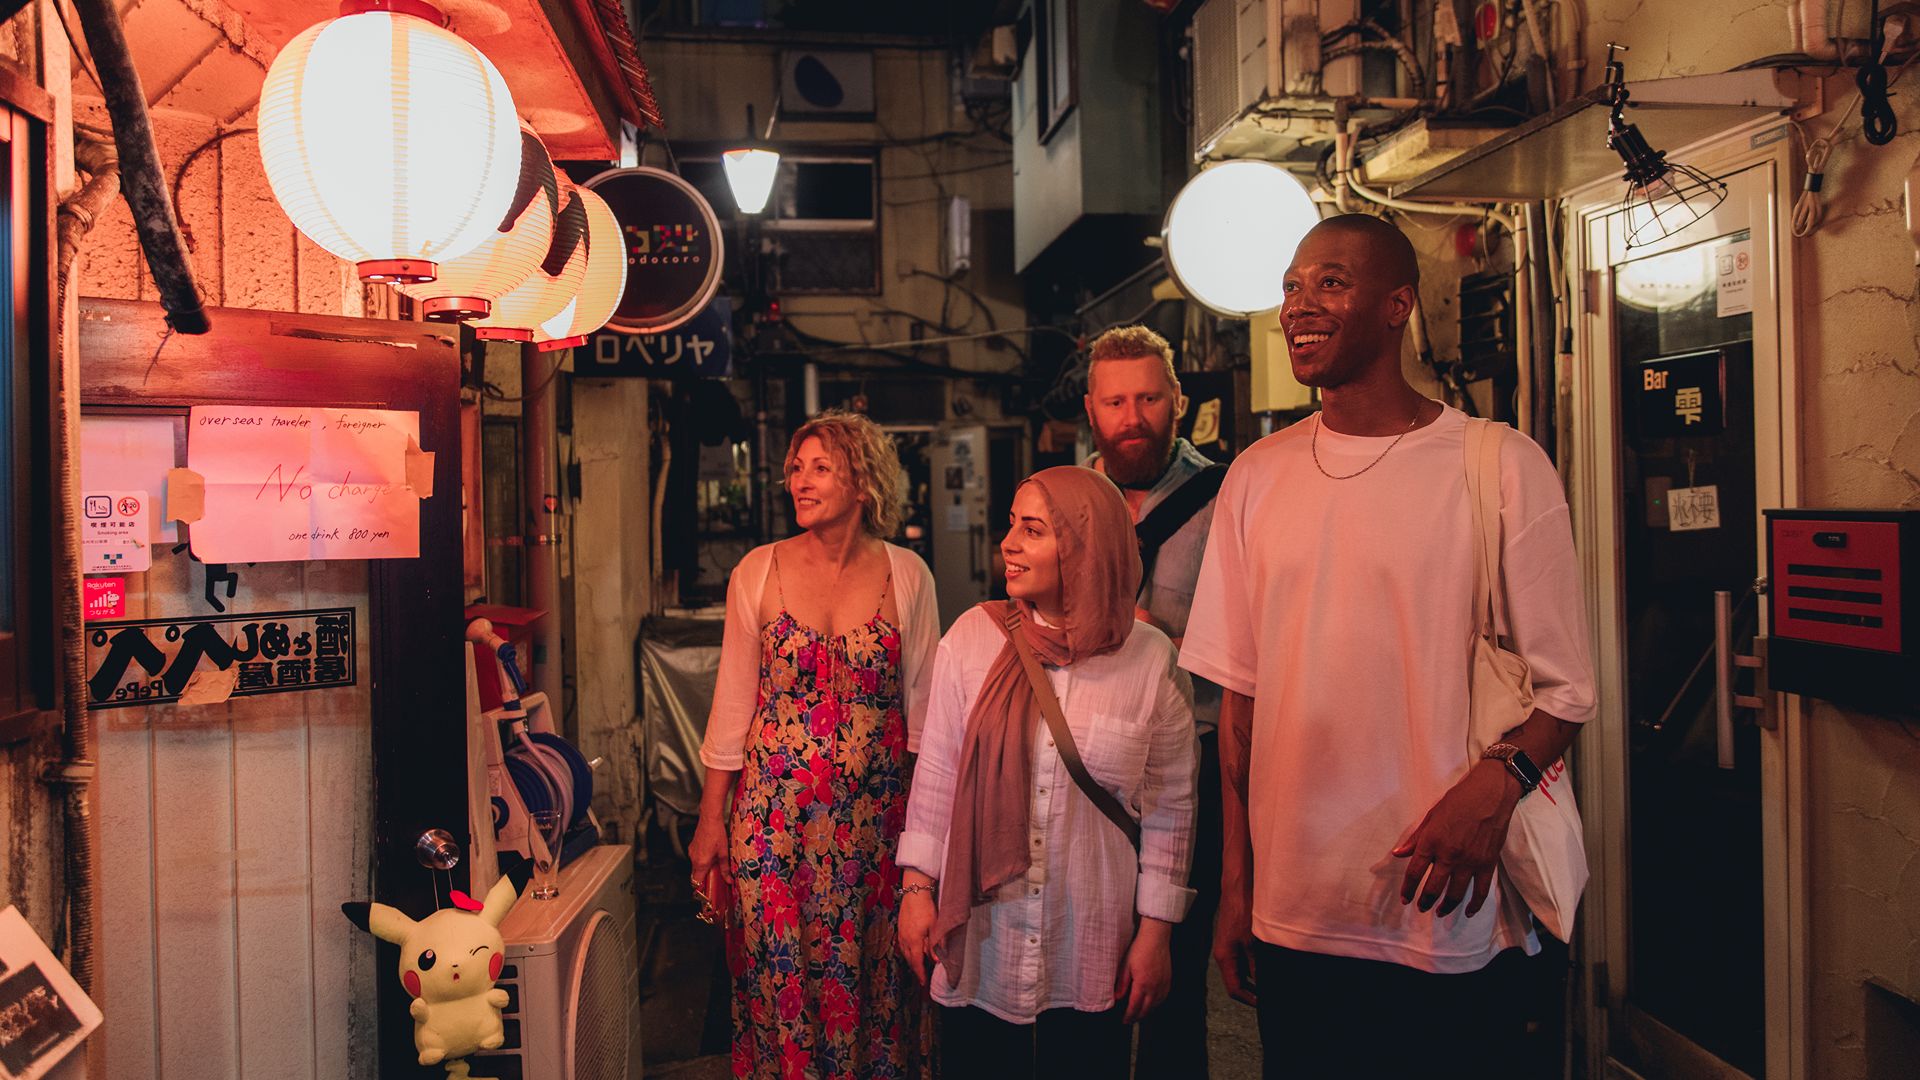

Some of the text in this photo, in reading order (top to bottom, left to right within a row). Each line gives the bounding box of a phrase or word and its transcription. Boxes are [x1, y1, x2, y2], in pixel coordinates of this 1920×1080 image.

[595, 334, 715, 365] ロベリヤ
[1643, 369, 1669, 391] Bar
[1675, 386, 1702, 425] 雫
[271, 414, 311, 427] traveler
[336, 413, 386, 434] foreigner
[256, 463, 393, 503] No charge
[288, 527, 390, 542] one drink 800 yen
